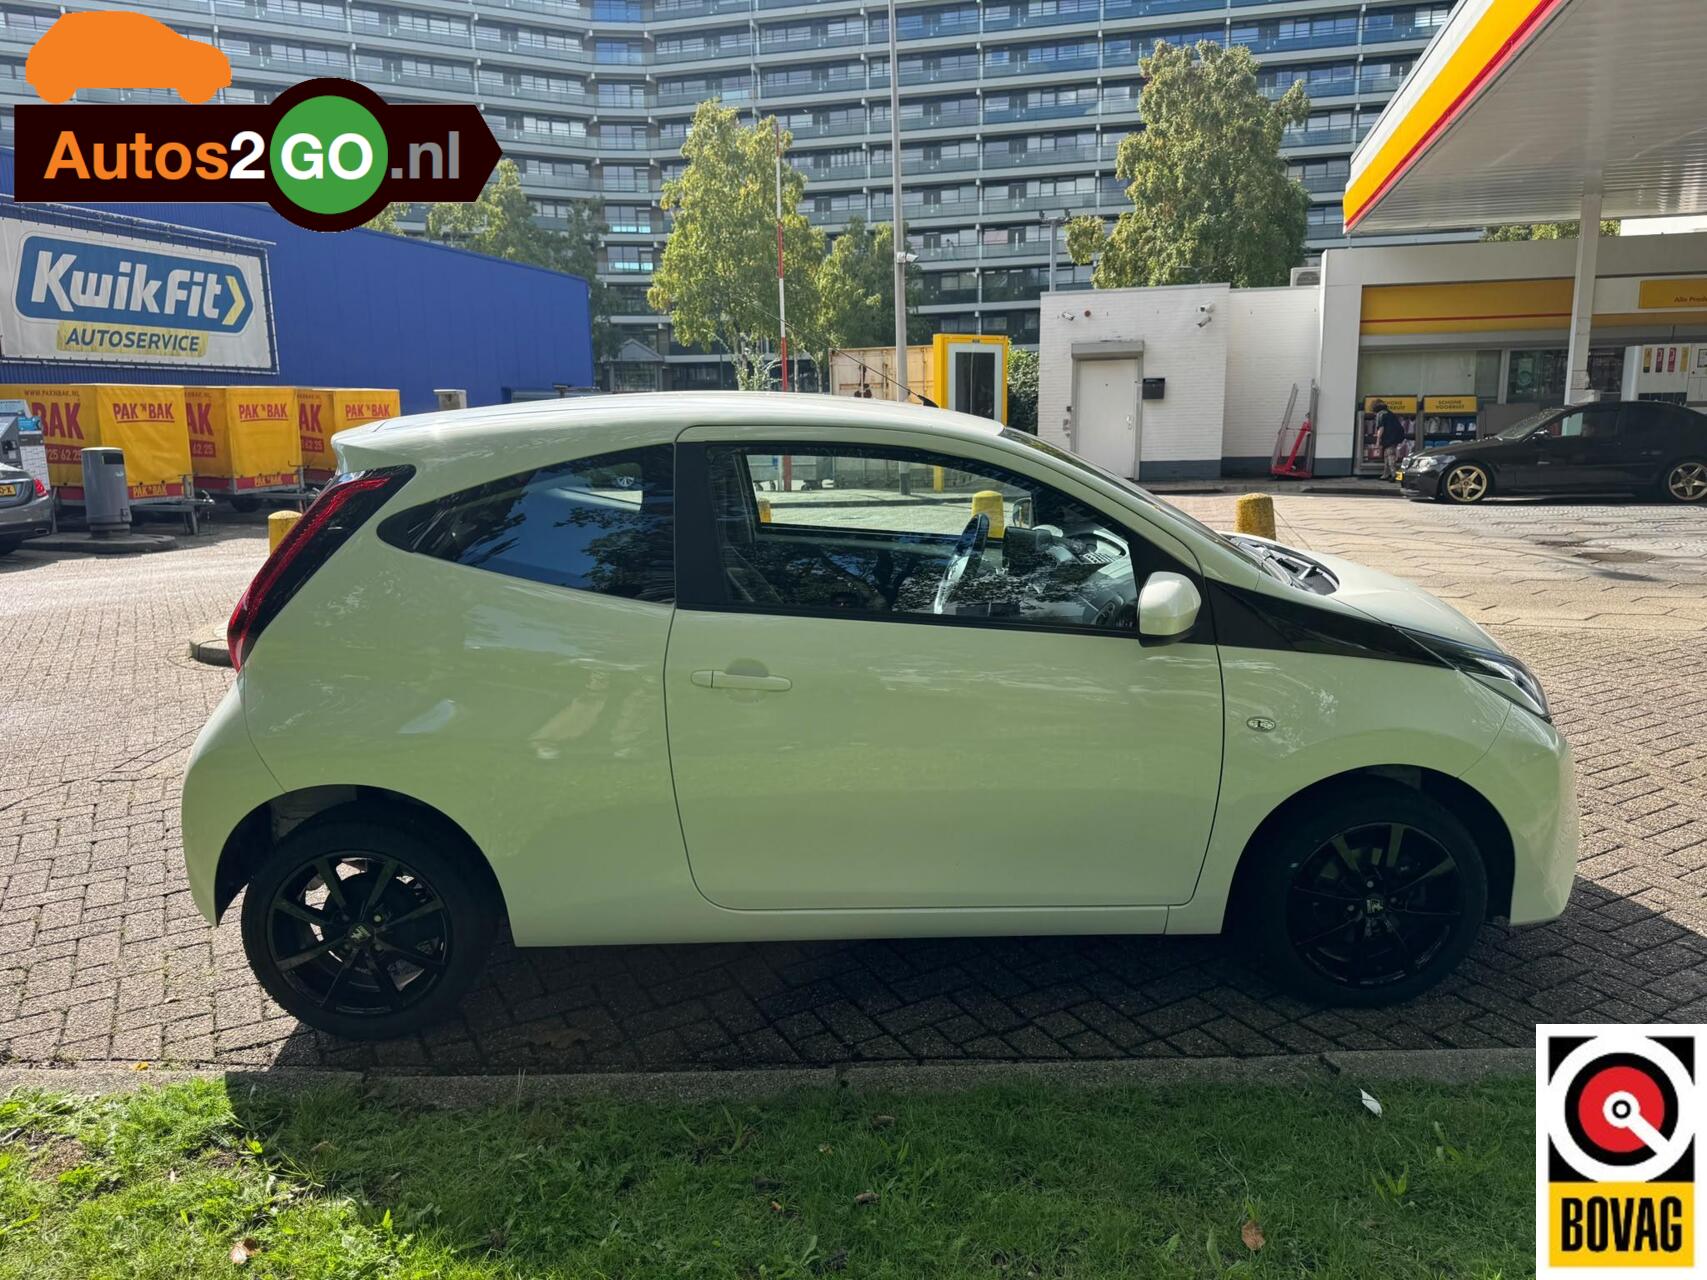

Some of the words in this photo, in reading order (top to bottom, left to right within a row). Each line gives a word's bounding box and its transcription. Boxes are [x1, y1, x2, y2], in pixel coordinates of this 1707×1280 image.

[65, 327, 200, 353] AUTOSERVICE
[112, 403, 139, 420] PAK
[149, 403, 175, 419] BAK
[239, 404, 259, 419] PAK
[266, 403, 288, 418] BAK
[299, 402, 322, 433] AK
[345, 404, 365, 417] PAK
[371, 404, 390, 417] BAK
[133, 484, 147, 497] PAK
[153, 483, 167, 496] BAK
